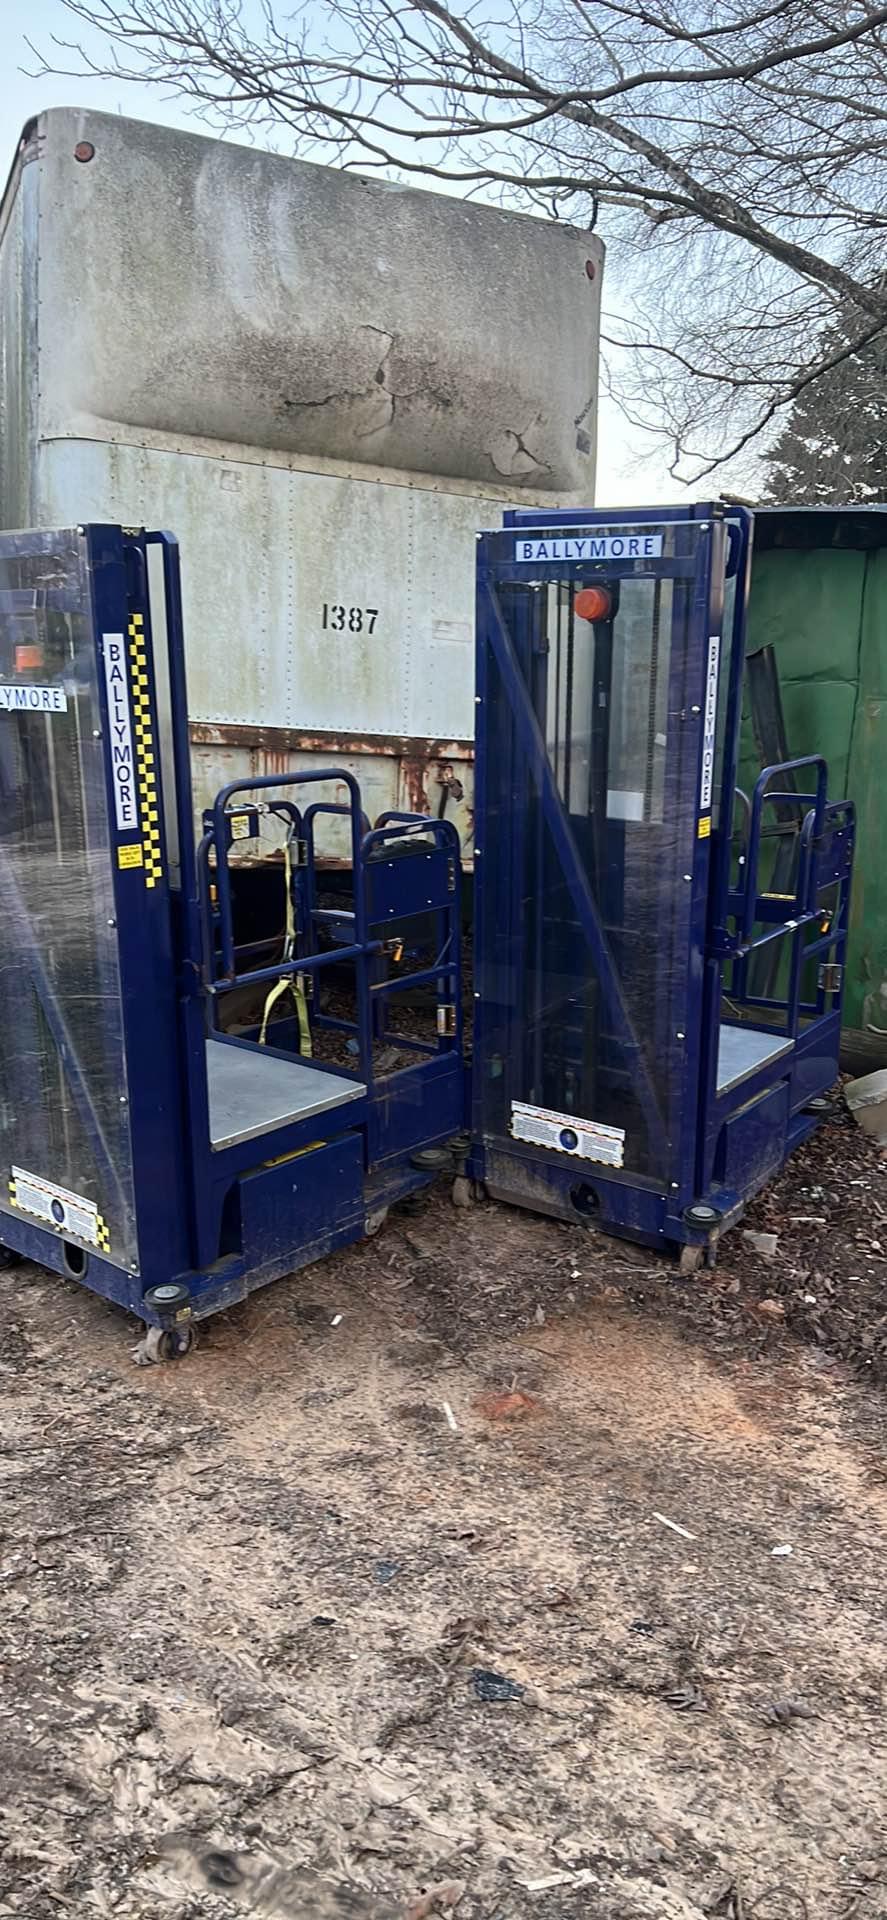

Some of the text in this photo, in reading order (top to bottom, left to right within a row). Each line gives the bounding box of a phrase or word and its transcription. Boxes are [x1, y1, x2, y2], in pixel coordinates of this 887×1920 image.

[523, 538, 654, 559] BALLYMORE
[322, 603, 379, 634] 1387
[109, 644, 132, 821] BALLYMORE
[704, 645, 717, 801] BALLYMORE
